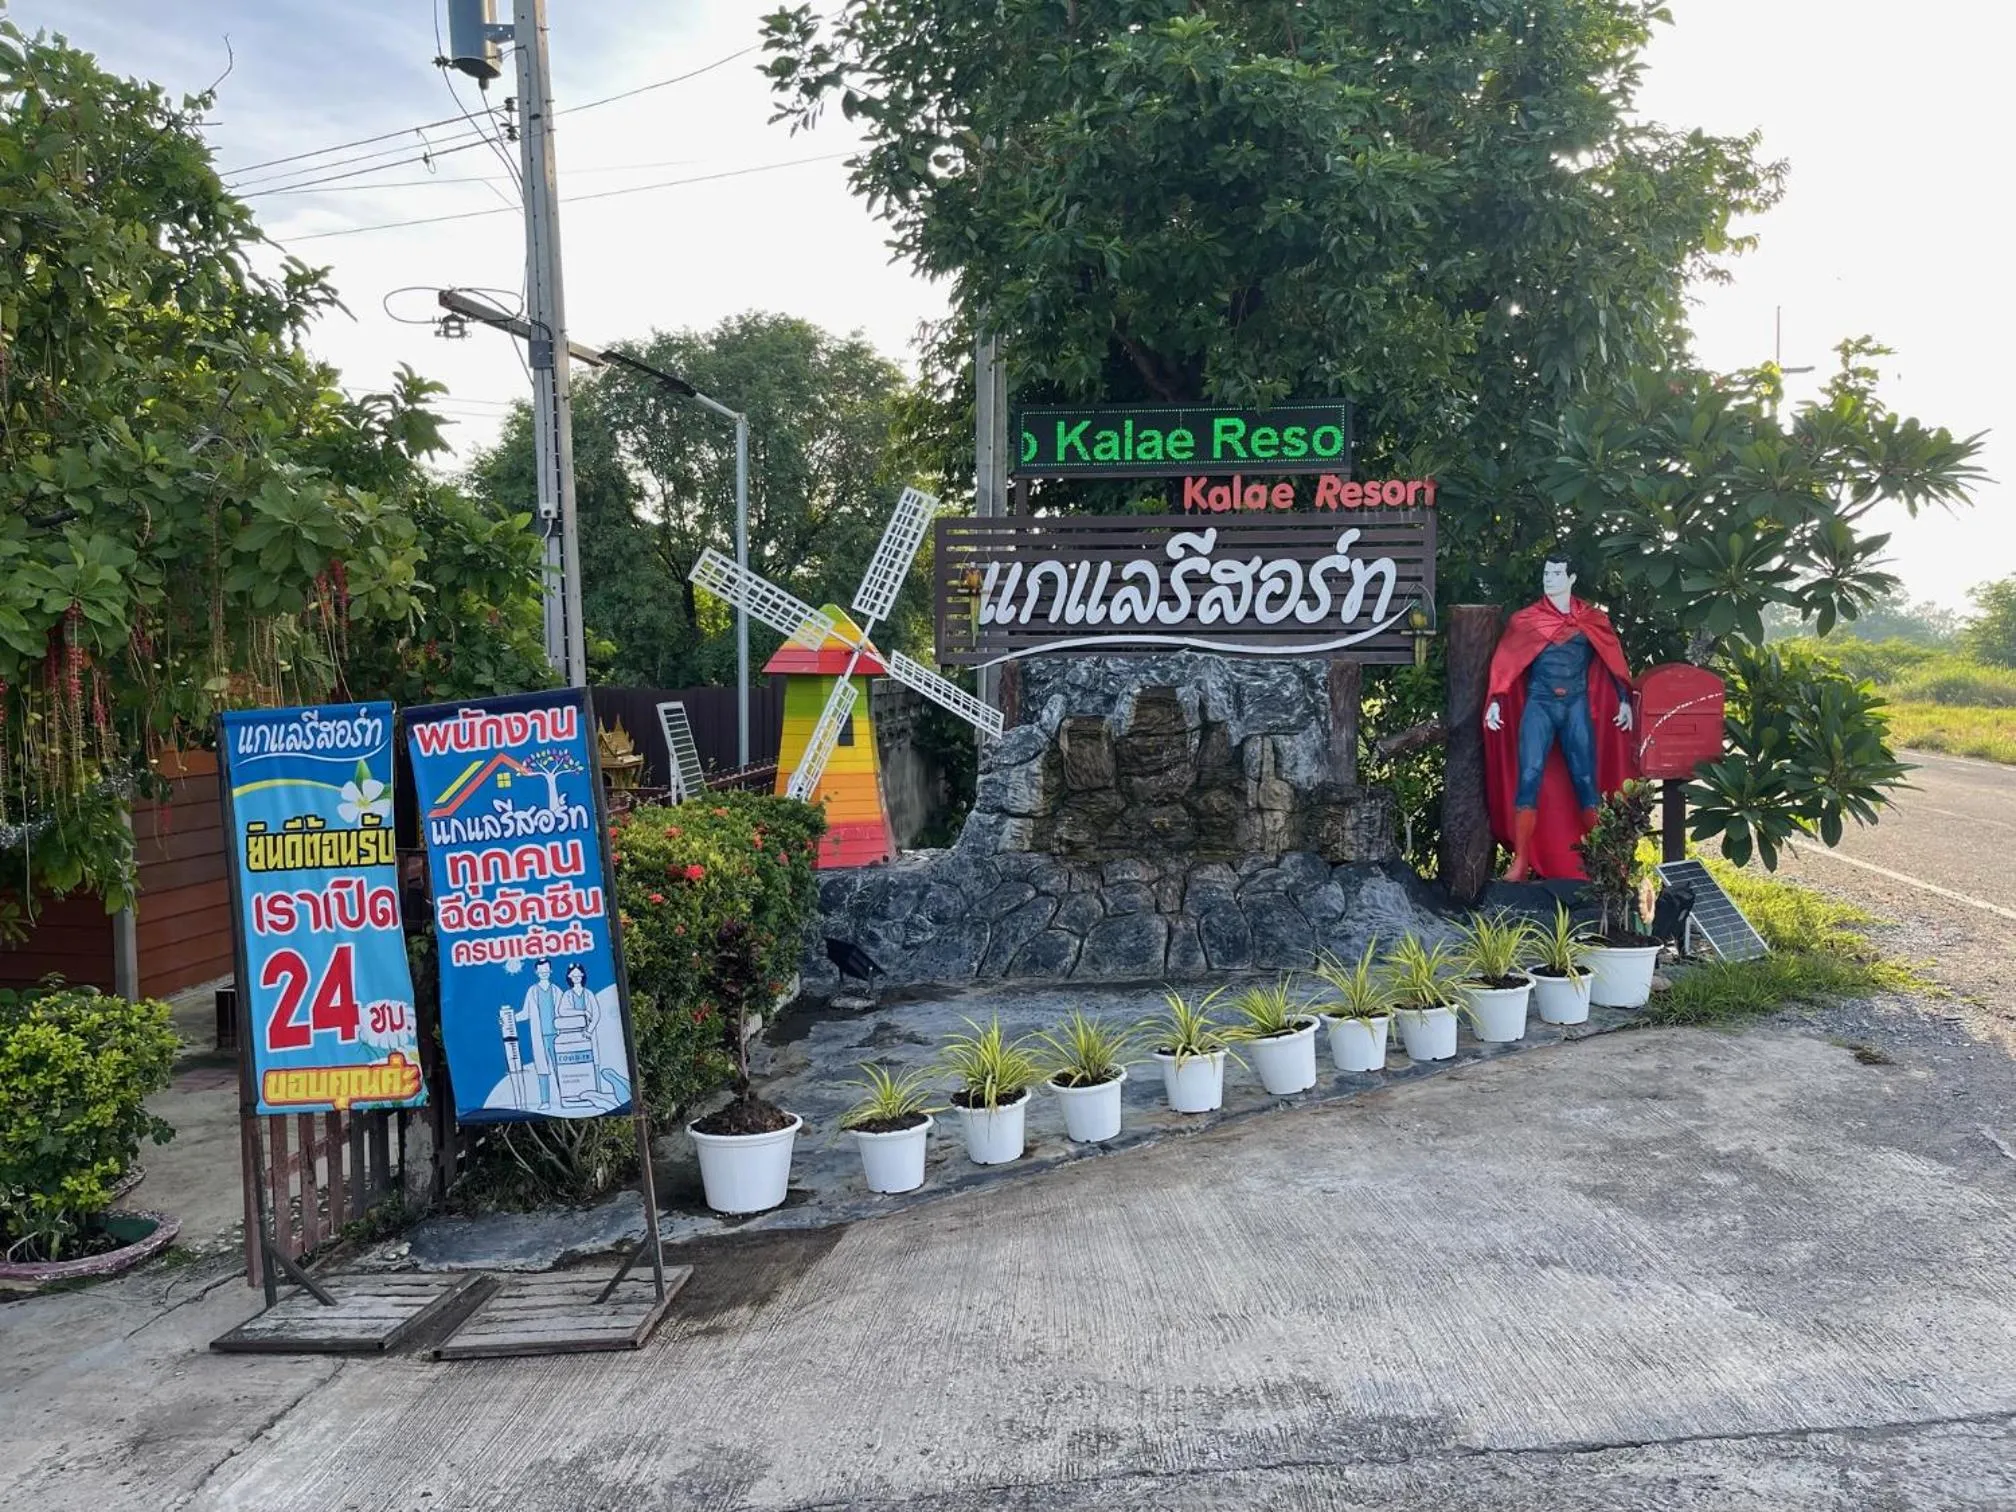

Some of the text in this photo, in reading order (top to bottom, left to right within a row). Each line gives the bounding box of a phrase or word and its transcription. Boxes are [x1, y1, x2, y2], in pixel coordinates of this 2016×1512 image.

[1056, 419, 1196, 461] Kalae
[1213, 417, 1344, 459] Reso
[1183, 474, 1438, 511] Kalae Resort
[979, 528, 1397, 625] แกแลรีสอร์ท
[237, 706, 383, 754] แกแลรีสอร์ท
[414, 706, 577, 756] พนักงาน
[431, 793, 589, 845] แกแลรีสอร์ท
[447, 840, 585, 897] ทุกคน
[253, 877, 400, 936] เราเปิด
[438, 882, 602, 933] ฉีดวัคซีน
[453, 922, 594, 966] ครบแล้วค่ะ
[261, 943, 361, 1052] 24
